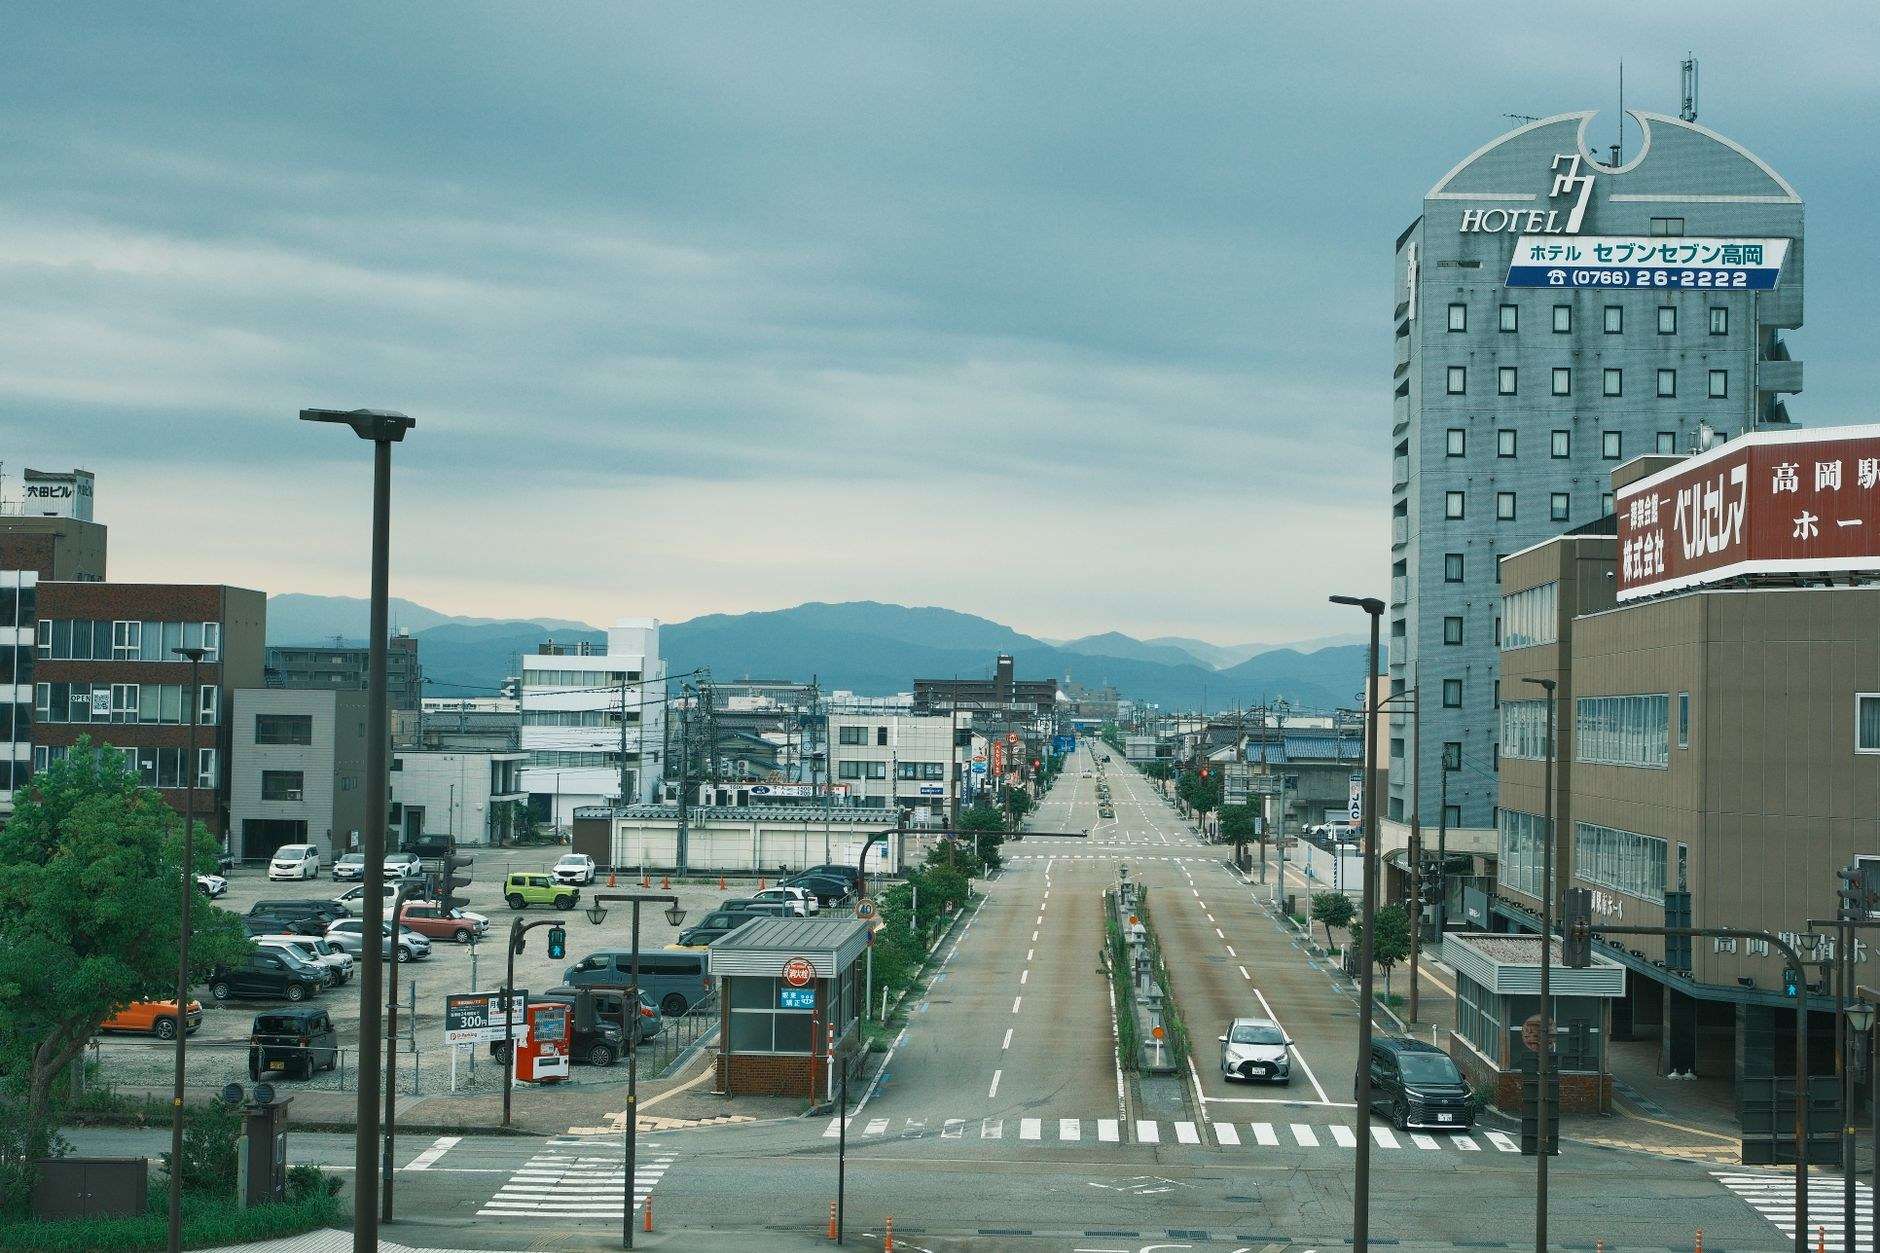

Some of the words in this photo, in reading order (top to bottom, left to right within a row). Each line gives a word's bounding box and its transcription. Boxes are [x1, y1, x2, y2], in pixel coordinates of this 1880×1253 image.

[1459, 208, 1564, 234] HOTEL
[1530, 245, 1582, 262] ホテル
[1593, 242, 1764, 266] セブンセブン高岡
[1572, 270, 1630, 286] (0766)
[1636, 271, 1747, 287] 26-2222
[27, 485, 73, 498] 穴田ビル
[1623, 527, 1666, 582] 株式会社
[70, 693, 91, 703] OPEN
[788, 968, 809, 979] 消火栓
